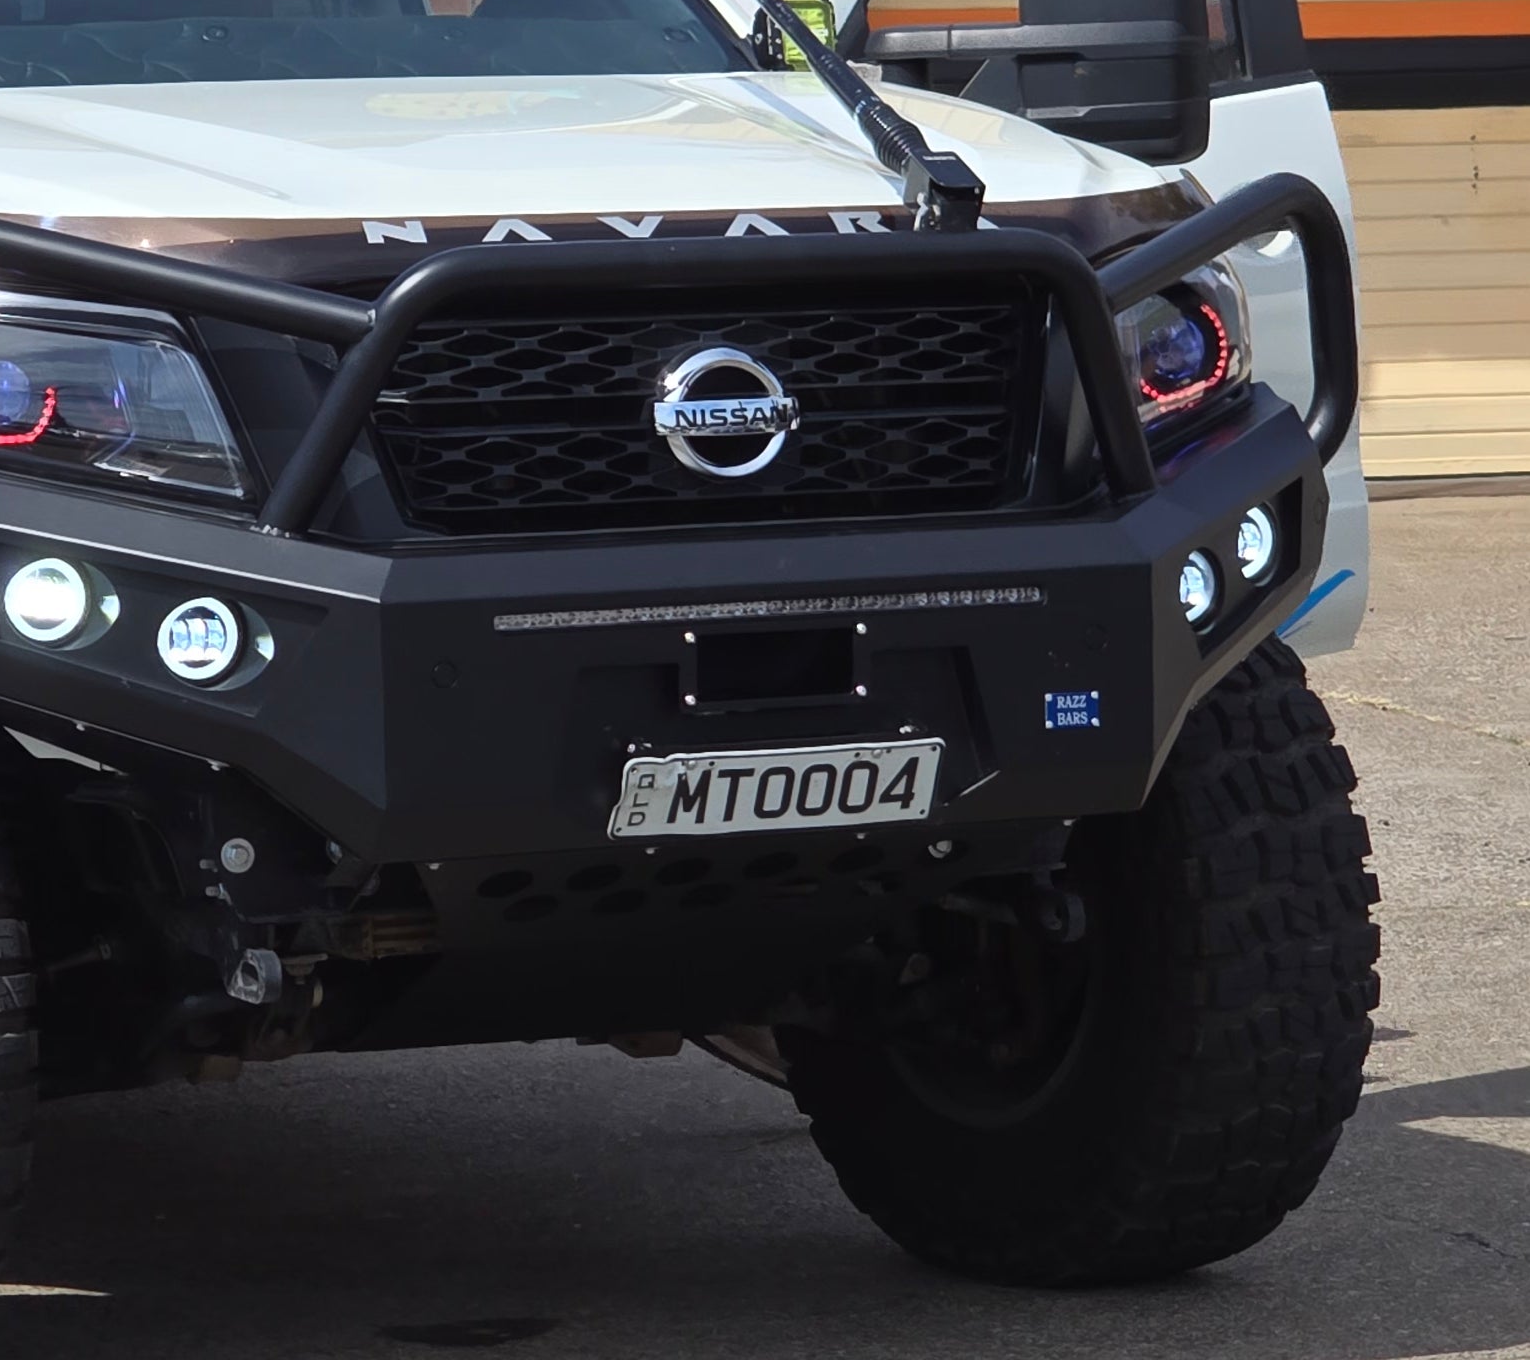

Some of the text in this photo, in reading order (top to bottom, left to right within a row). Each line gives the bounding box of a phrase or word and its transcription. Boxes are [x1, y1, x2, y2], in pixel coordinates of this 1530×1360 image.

[362, 213, 1000, 244] NAVAR
[674, 402, 789, 428] NISSAN
[1057, 695, 1087, 709] RAZZ
[1057, 711, 1088, 726] BARS
